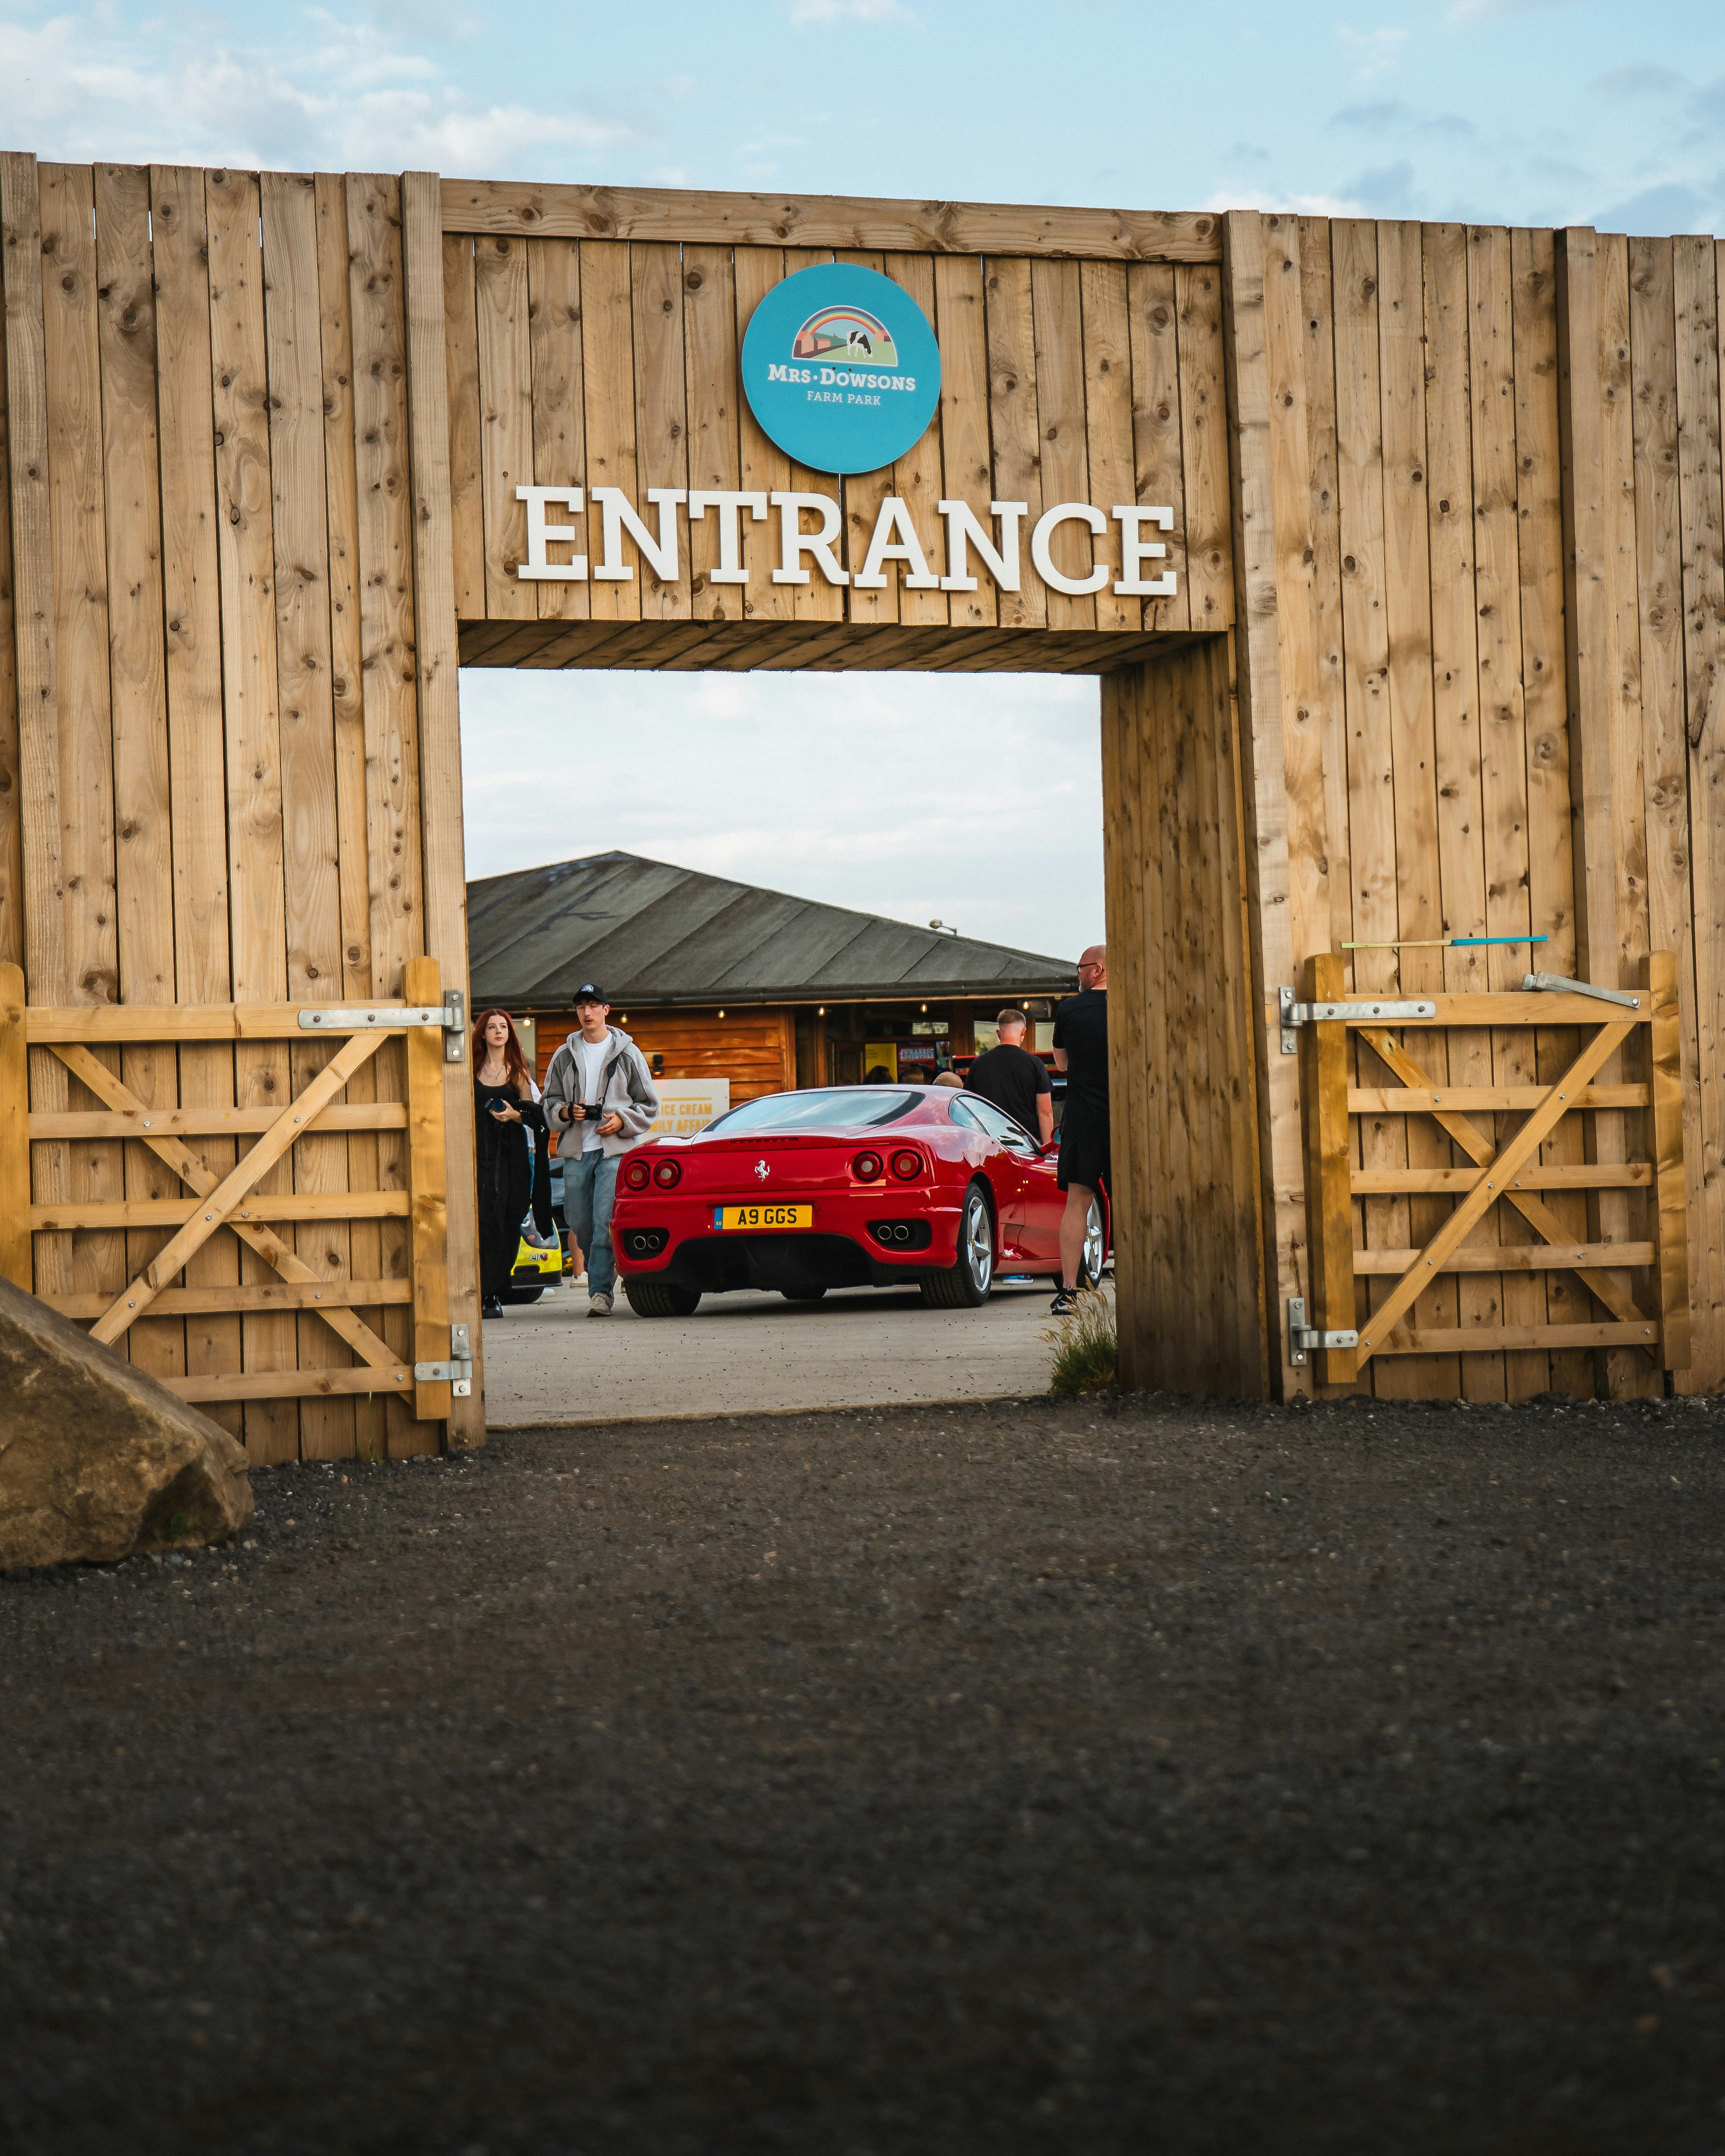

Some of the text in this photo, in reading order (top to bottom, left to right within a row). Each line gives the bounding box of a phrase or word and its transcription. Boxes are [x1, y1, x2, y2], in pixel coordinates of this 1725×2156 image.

[807, 391, 881, 406] FARM PARK
[515, 485, 1177, 595] ENTRANCE
[661, 1103, 712, 1115] ICE CREAM
[737, 1208, 797, 1225] A9 GGS
